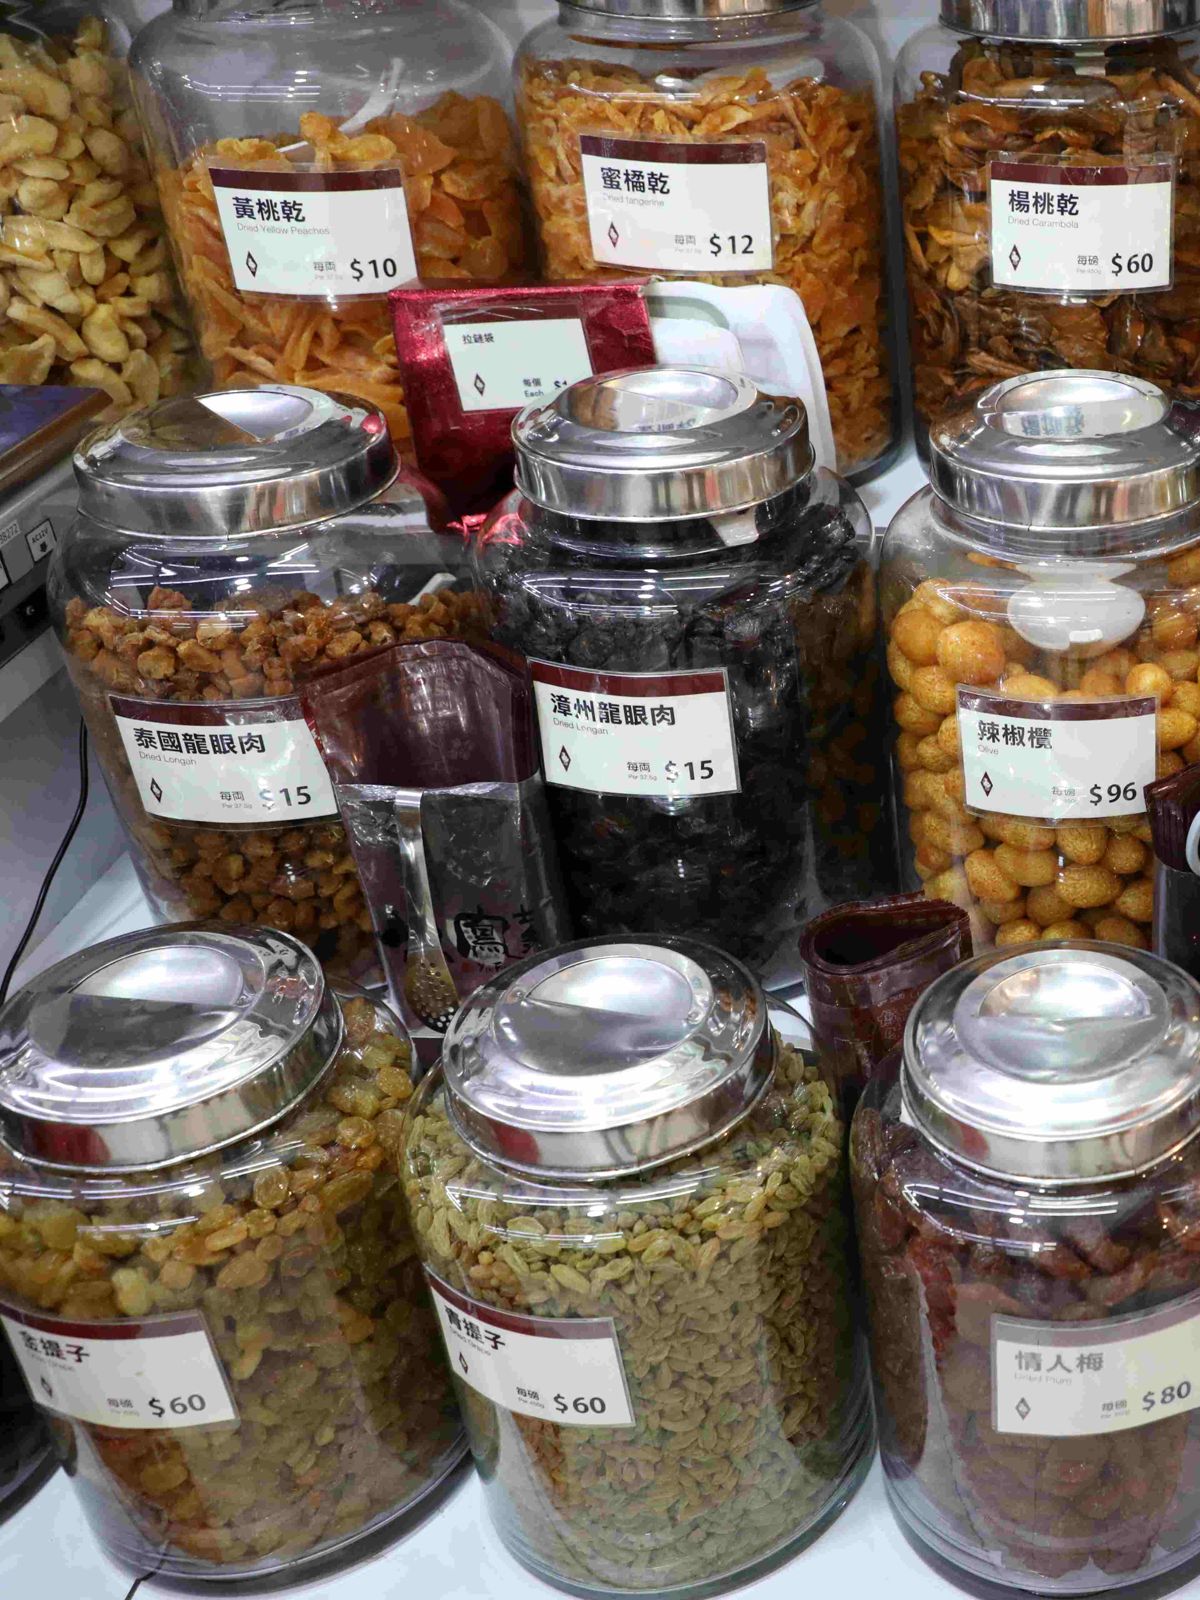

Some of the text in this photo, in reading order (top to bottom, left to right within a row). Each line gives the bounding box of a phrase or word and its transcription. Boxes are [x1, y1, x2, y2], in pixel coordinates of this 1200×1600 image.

[600, 166, 670, 195] 蜜橘乾
[232, 196, 306, 222] 黃桃乾
[1008, 190, 1079, 215] 楊桃乾
[237, 223, 330, 235] Dried Yellow Peaches
[1008, 216, 1079, 229] Dried Carambola
[709, 233, 754, 257] $12
[350, 258, 397, 282] $10
[1111, 253, 1153, 276] $60
[524, 390, 544, 398] Each
[550, 693, 675, 726] 漳州龍眼肉
[553, 717, 574, 729] Dried
[978, 720, 1053, 749] 辣椒欖
[133, 727, 266, 755] 泰國龍眼肉
[139, 751, 196, 765] Dried Longan
[664, 759, 714, 784] $15
[259, 785, 311, 810] $15
[1089, 782, 1137, 806] $96
[1015, 1350, 1104, 1374] 情人梅
[148, 1394, 206, 1418] $60
[553, 1393, 606, 1414] $60
[1142, 1380, 1192, 1412] $80
